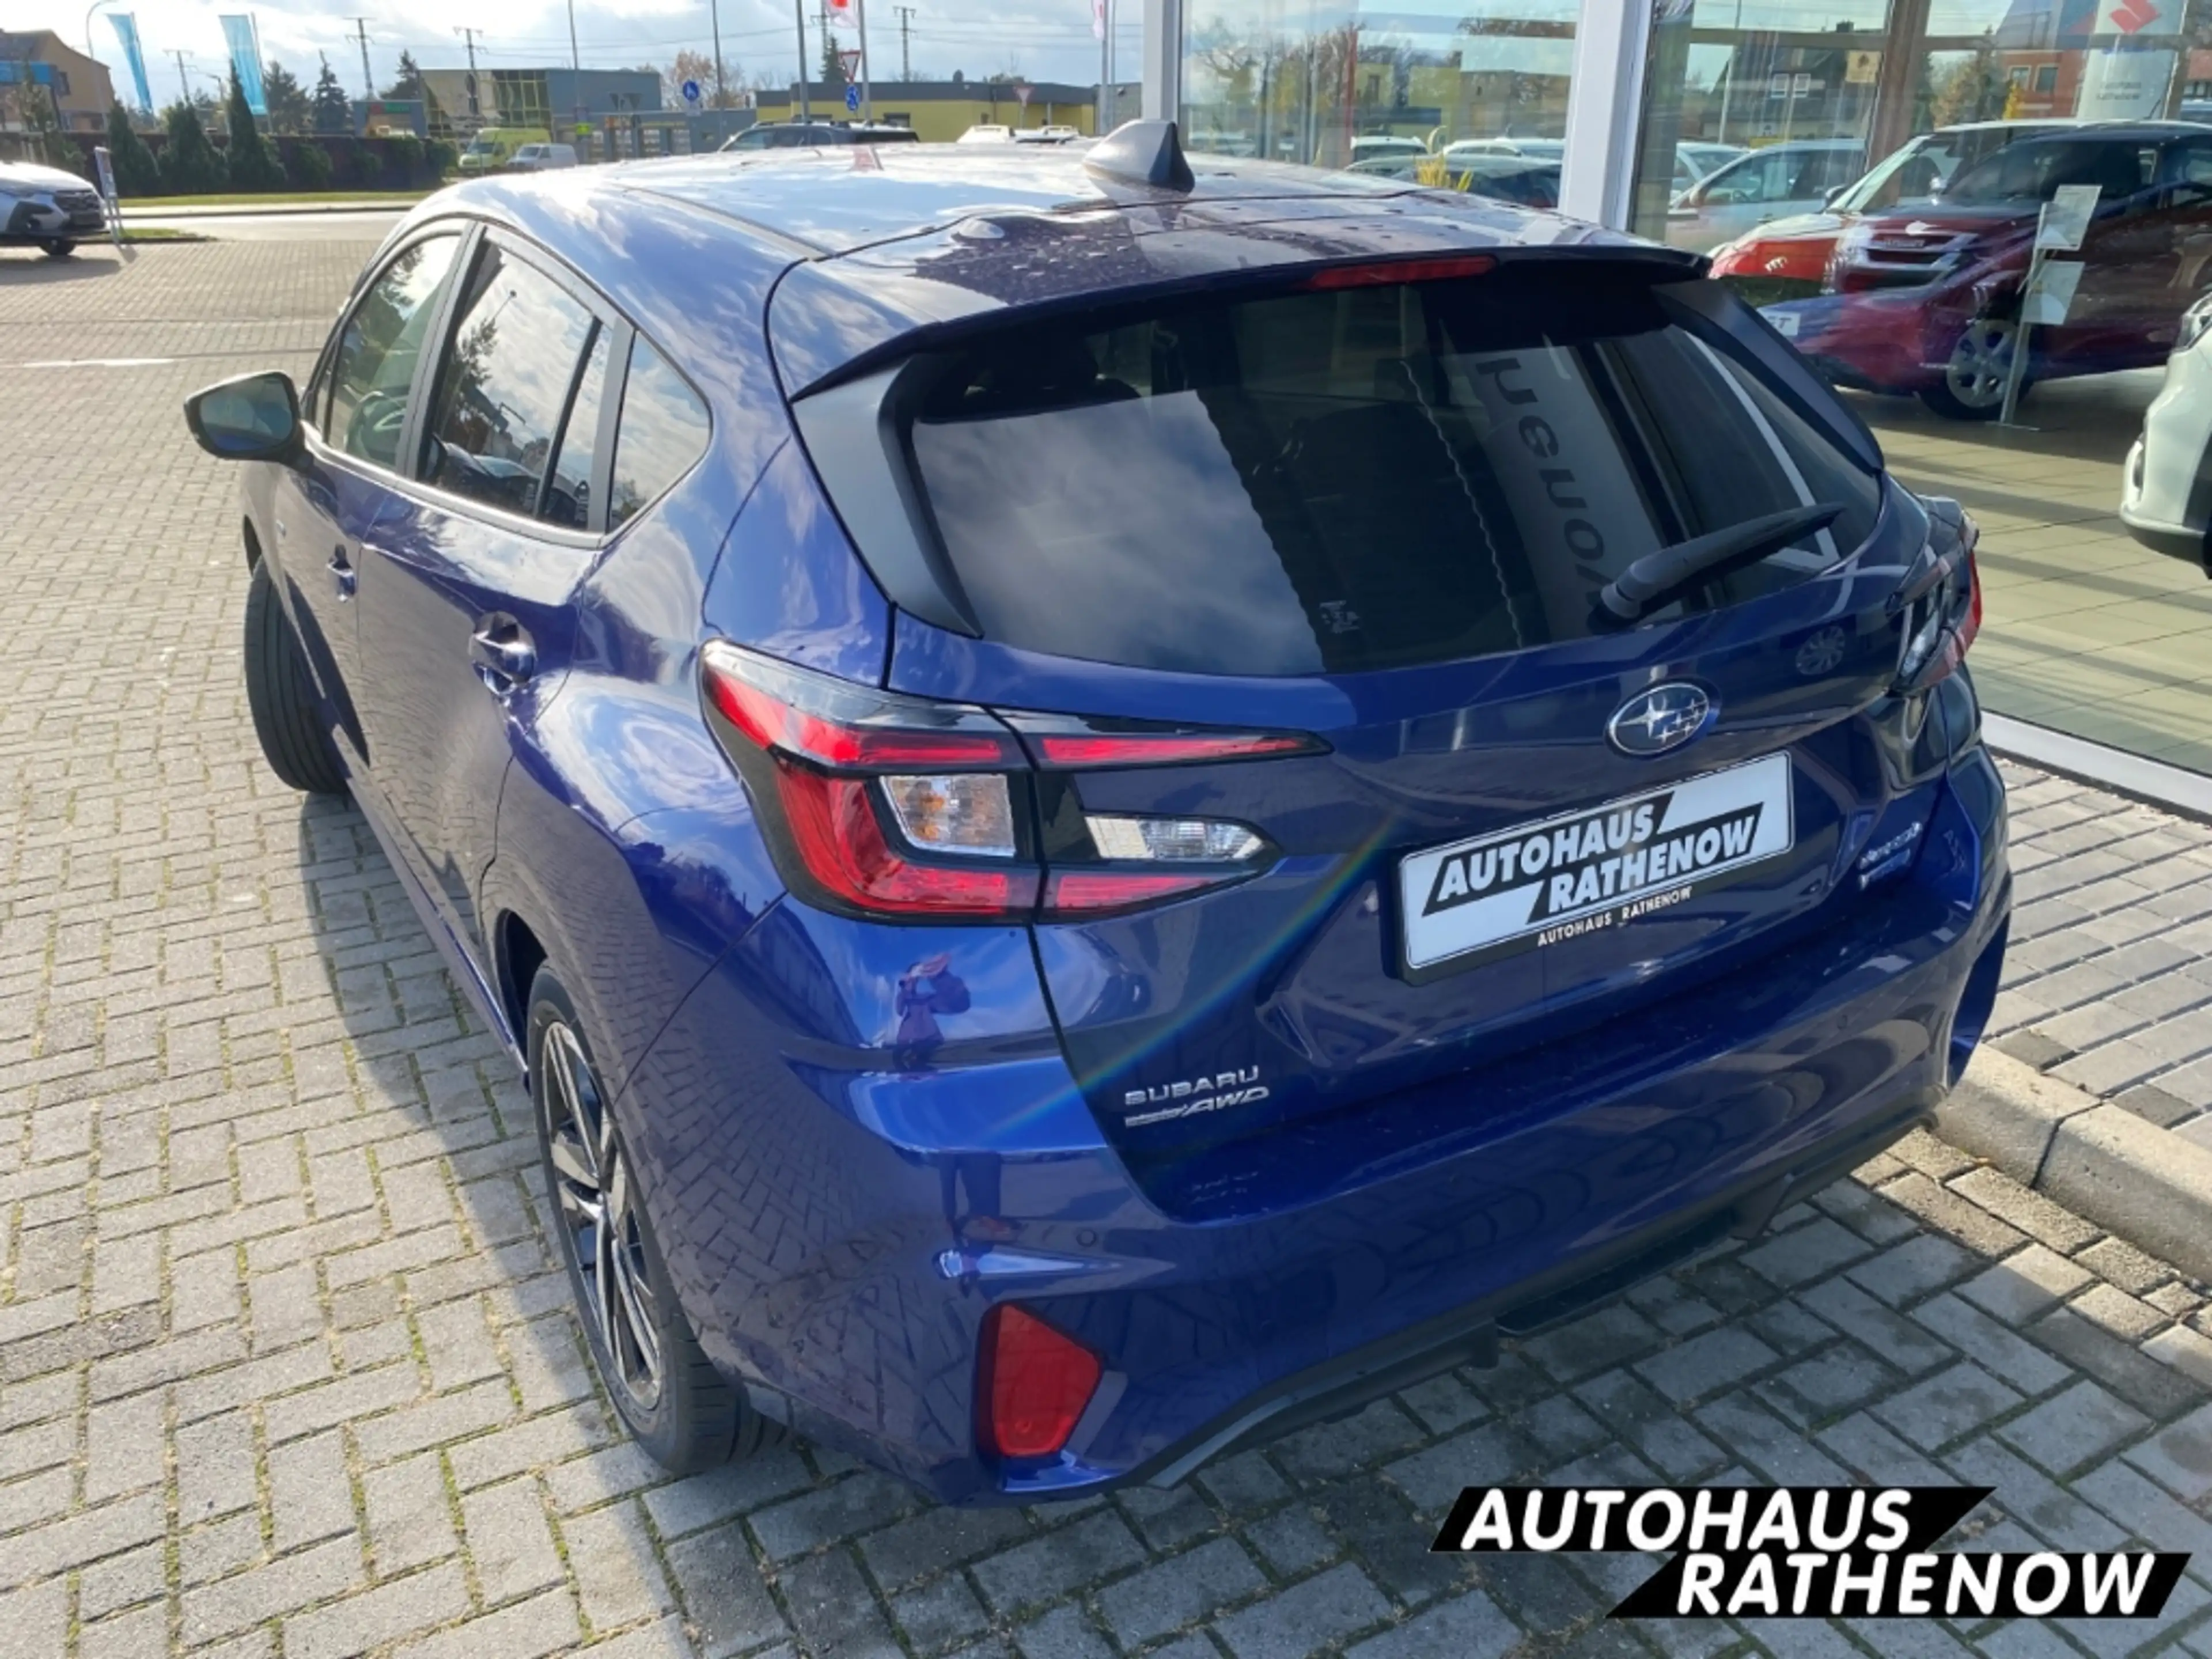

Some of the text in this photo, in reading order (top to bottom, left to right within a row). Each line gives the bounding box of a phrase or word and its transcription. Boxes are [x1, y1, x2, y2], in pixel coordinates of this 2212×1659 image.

[1437, 804, 1653, 902] AUTOHAUS
[1548, 816, 1755, 915] RATHENOW
[1537, 886, 1692, 947] AUTOHAUS RATHENOW
[1125, 1065, 1259, 1105] SUBARU
[1181, 1086, 1270, 1118] AWD
